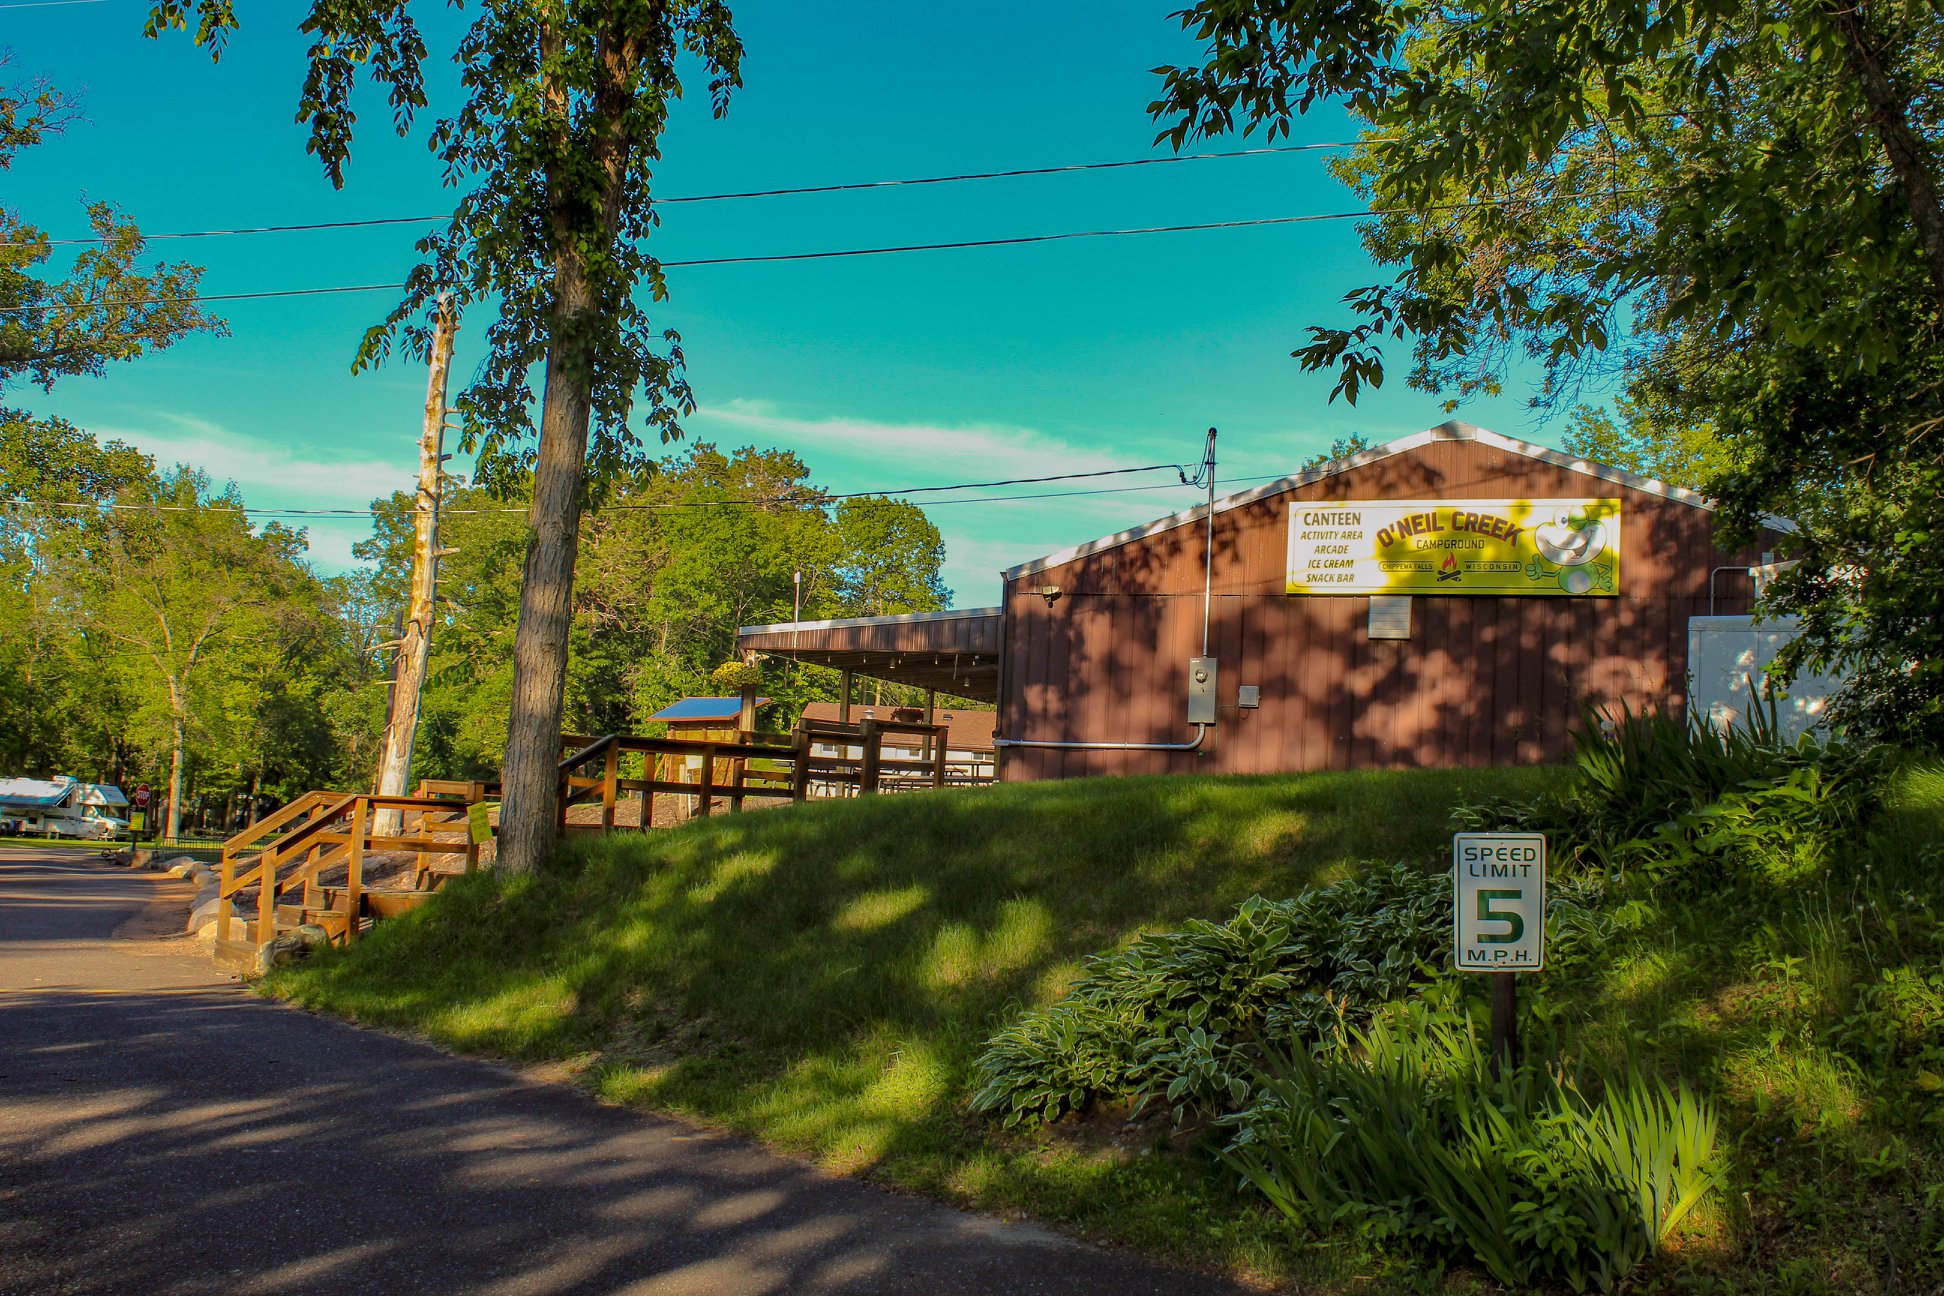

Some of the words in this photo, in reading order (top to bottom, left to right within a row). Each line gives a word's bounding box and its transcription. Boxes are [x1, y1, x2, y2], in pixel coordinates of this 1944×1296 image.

[1303, 512, 1361, 526] CANTEEN
[1376, 511, 1444, 548] O'NEIL
[1451, 511, 1524, 548] CREEK
[1300, 531, 1339, 540] ACTIVITY
[1340, 531, 1363, 540] AREA
[1314, 545, 1349, 554] ARCADE
[1416, 539, 1485, 549] CAMPGROUND
[1308, 559, 1321, 568] ICE
[1323, 559, 1354, 568] CREAM
[1306, 573, 1335, 583] SNACK
[1336, 573, 1355, 583] BAR
[137, 791, 149, 800] STOP
[1464, 847, 1536, 862] SPEED
[1469, 864, 1531, 877] LIMIT
[1477, 889, 1524, 943] 5
[1467, 949, 1532, 961] M.P.H.
